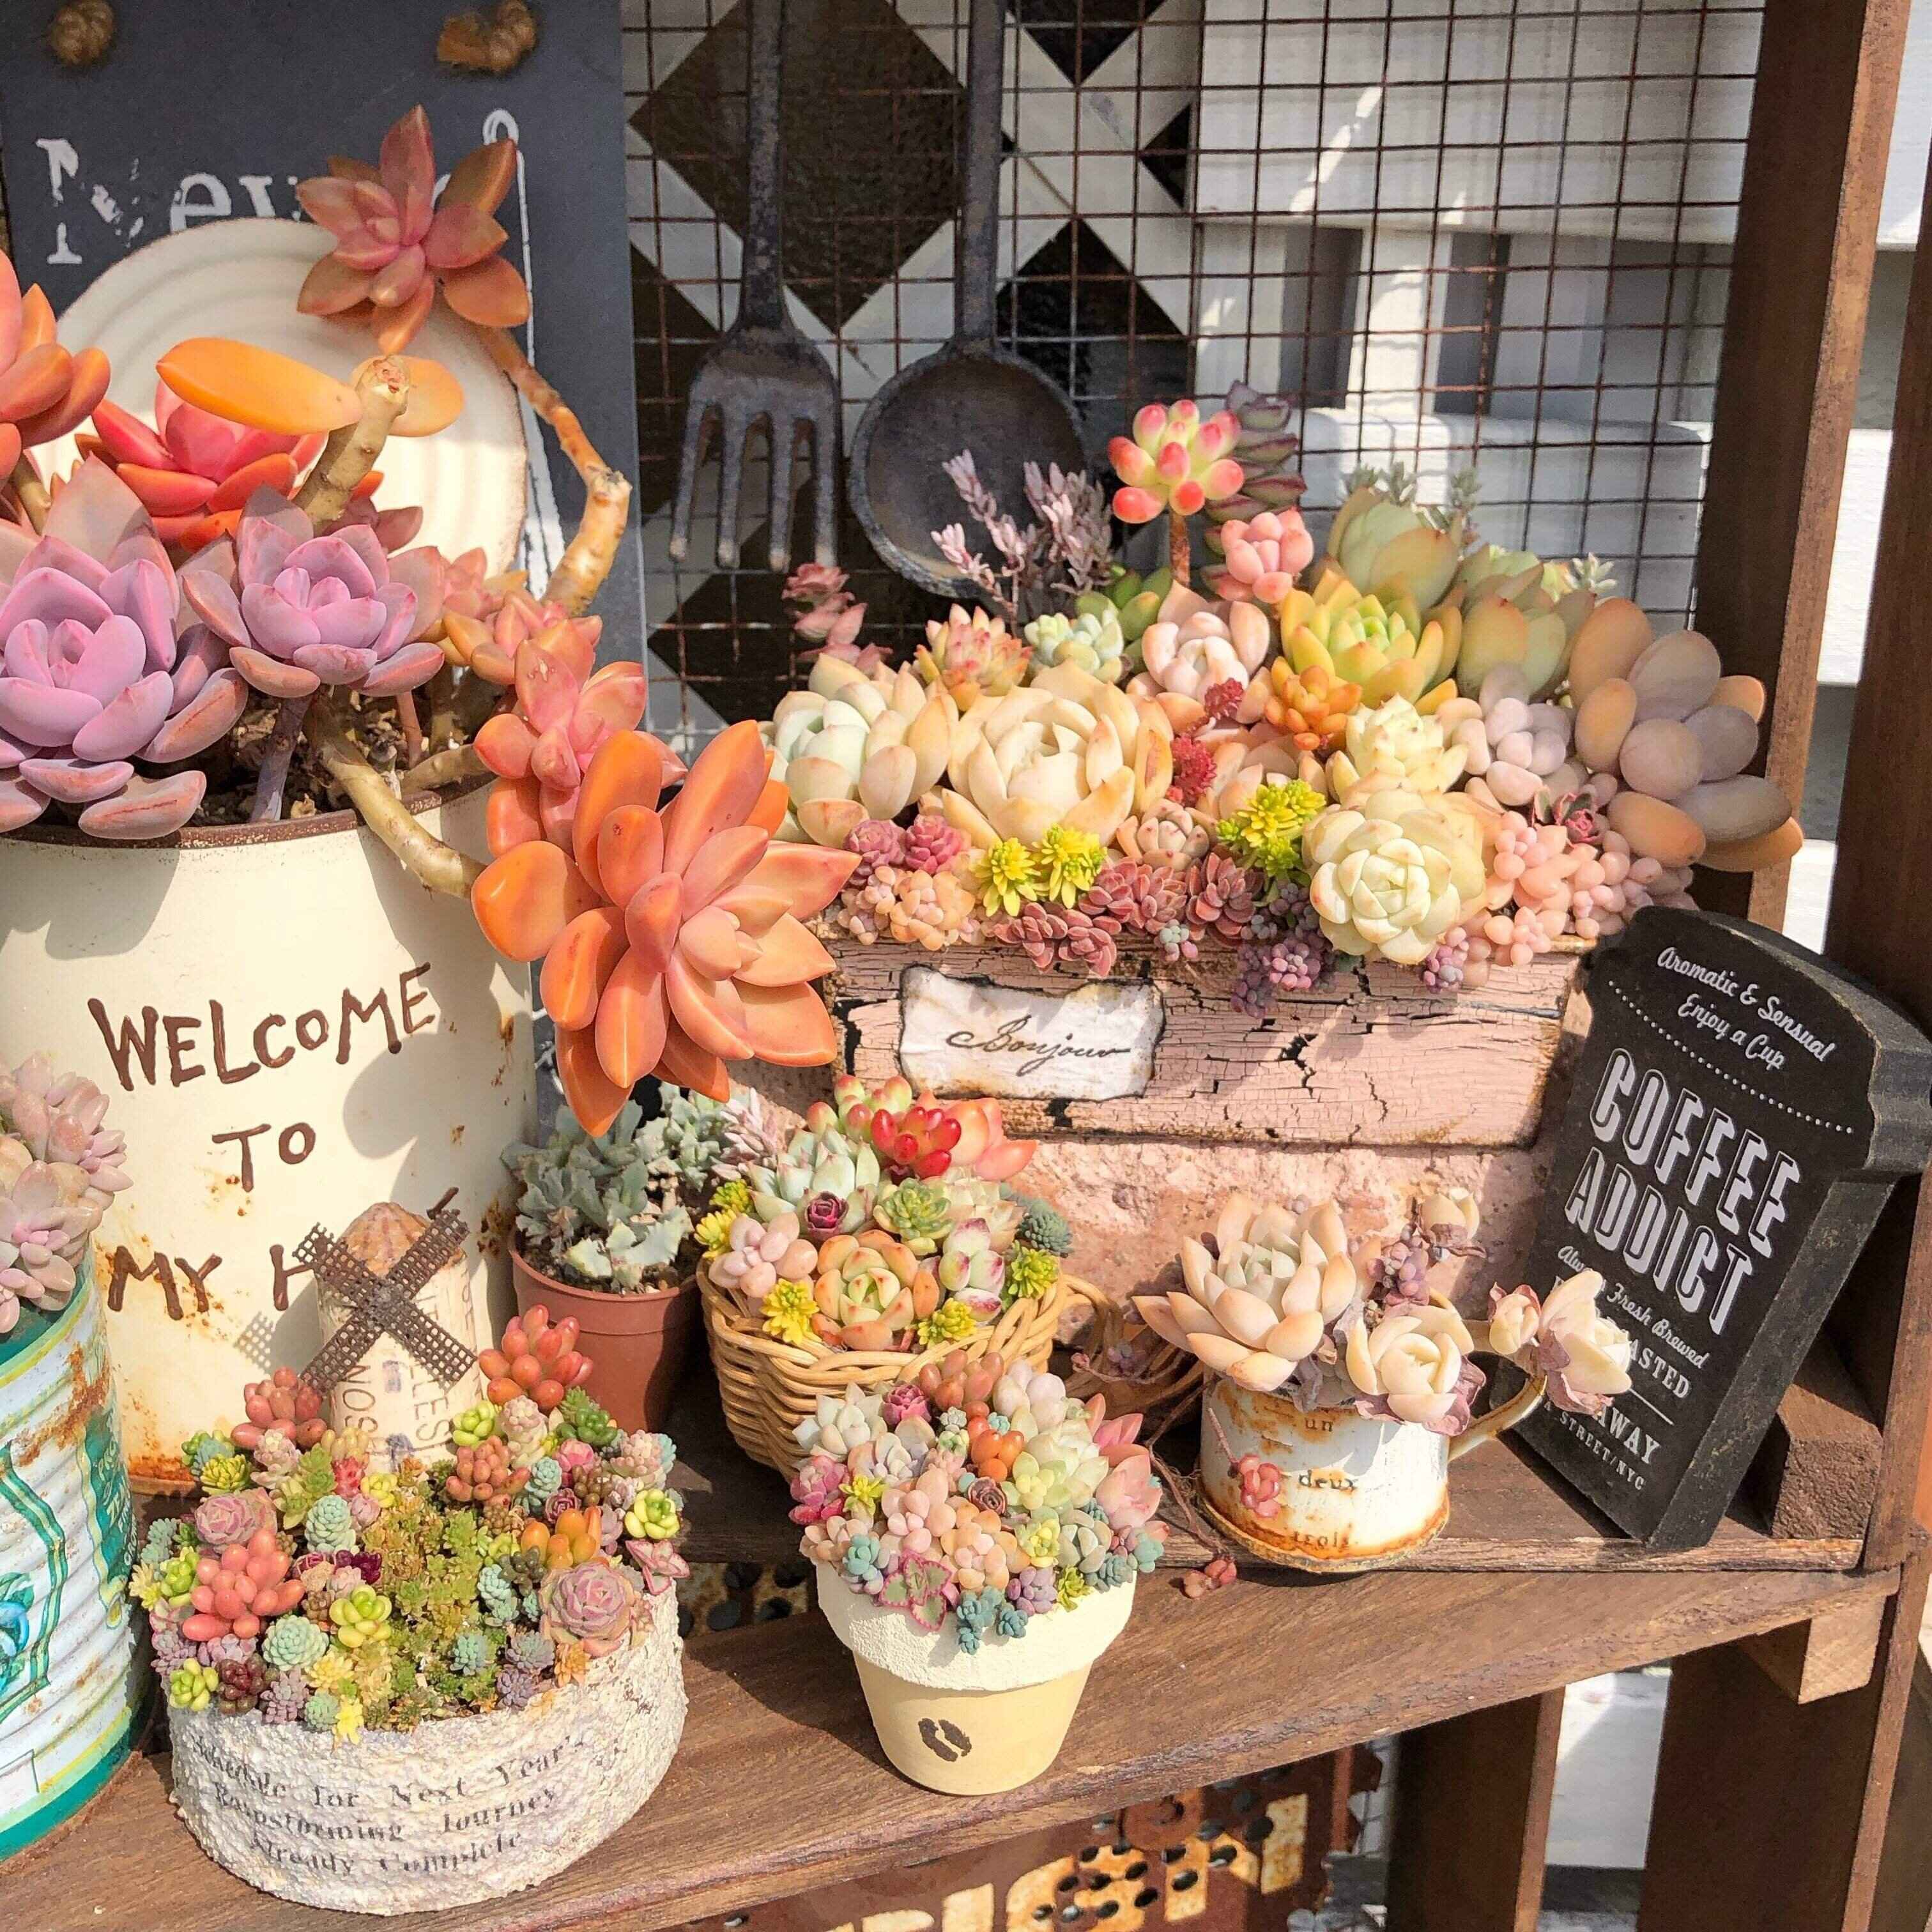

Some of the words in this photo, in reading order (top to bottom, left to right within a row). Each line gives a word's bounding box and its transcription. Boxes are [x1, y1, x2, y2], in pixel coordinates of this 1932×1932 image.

[88, 962, 436, 1091] WELCOME
[1657, 947, 1740, 997] Aromatic
[1740, 984, 1759, 1005] &
[1758, 996, 1836, 1061] Sensual
[1678, 993, 1730, 1040] Enjoy
[1729, 1030, 1747, 1046] a
[1745, 1034, 1786, 1071] Cup
[946, 1014, 1131, 1077] Bonjour
[211, 1122, 317, 1192] TO
[1590, 1048, 1800, 1258] COFFEE
[1565, 1147, 1753, 1335] ADDICT
[107, 1245, 222, 1321] MY
[1606, 1283, 1653, 1326] Fresh
[1652, 1319, 1710, 1369] Brewed
[1305, 1417, 1334, 1432] un
[312, 1784, 359, 1807] for
[388, 1777, 467, 1807] Next
